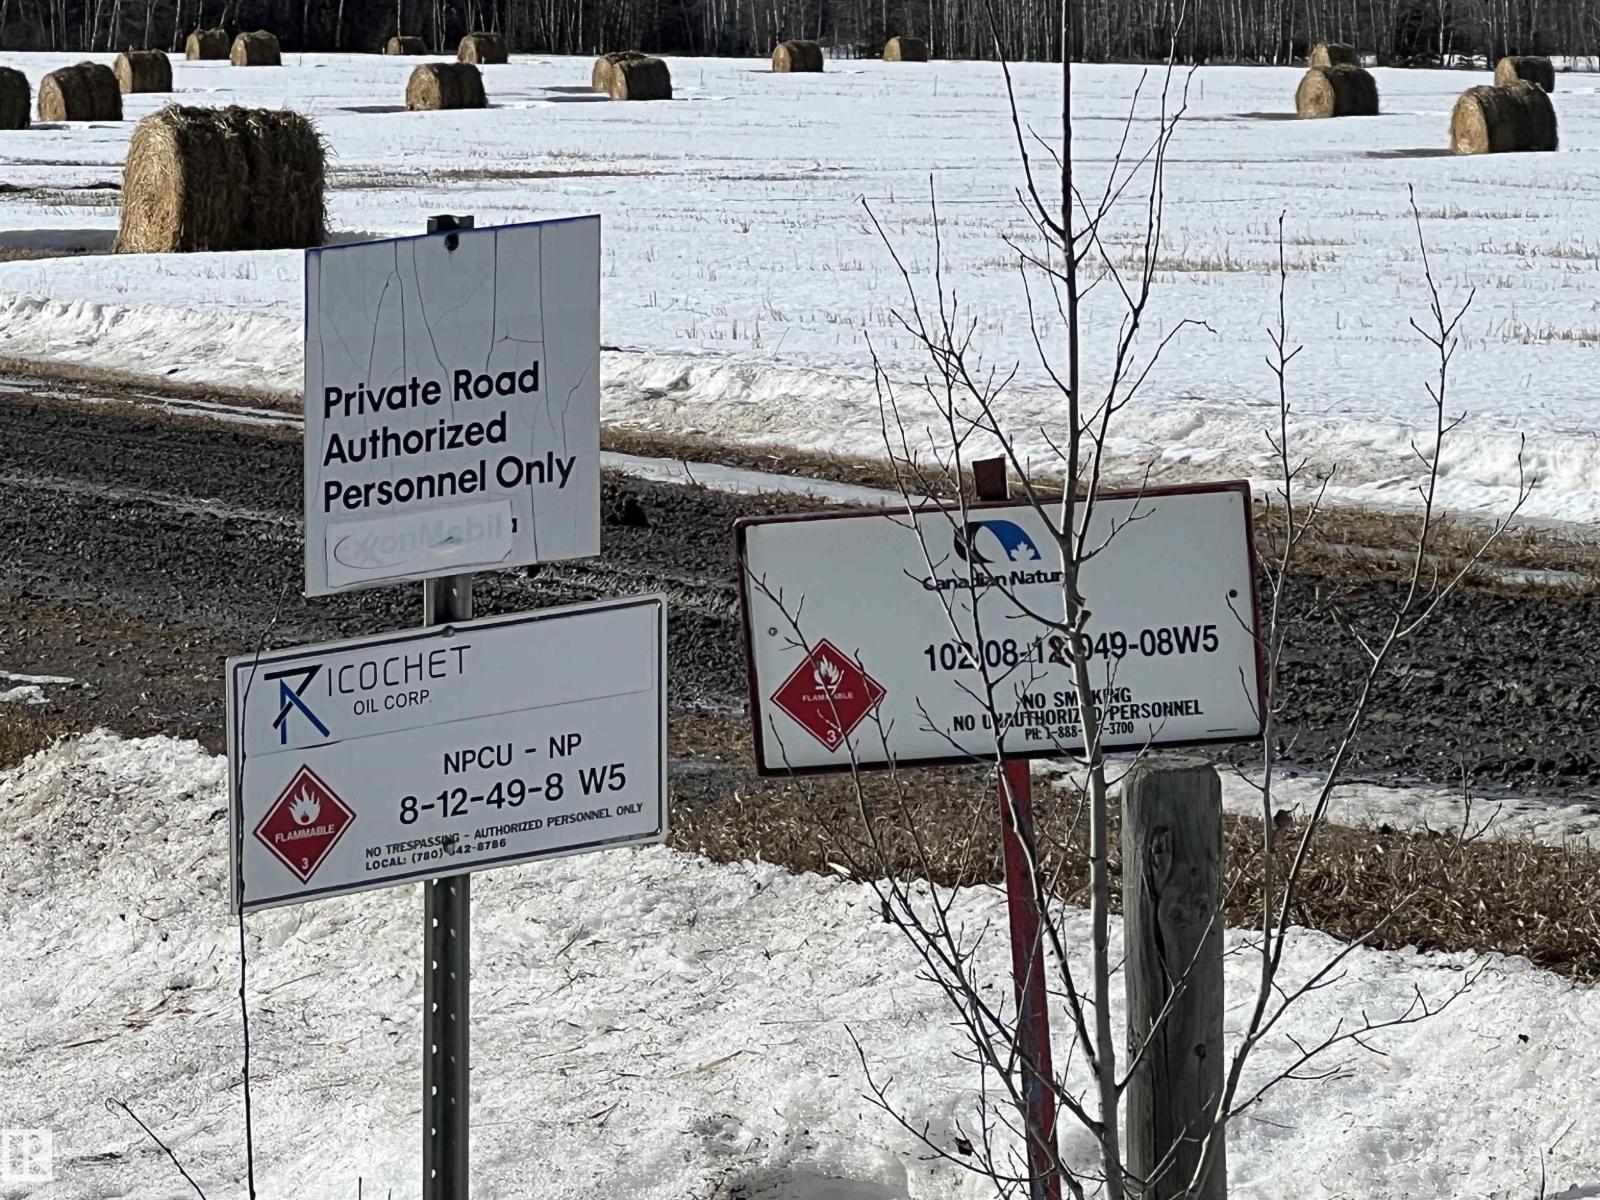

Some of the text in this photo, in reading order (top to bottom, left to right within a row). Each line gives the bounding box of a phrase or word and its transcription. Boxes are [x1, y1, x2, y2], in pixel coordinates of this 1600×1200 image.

[324, 361, 539, 419] Private Road
[323, 411, 507, 466] Authorized
[324, 451, 576, 512] Personnel Only
[1011, 570, 1064, 585] Natur
[353, 689, 432, 715] OIL CORP.
[802, 691, 854, 702] FLAMABLE
[1022, 687, 1132, 709] NO SMKING
[953, 699, 1204, 731] NO UNAUTHORIZD PERSONNEL
[827, 729, 837, 743] 3
[1046, 721, 1134, 740] 1-888--3700
[444, 743, 513, 775] NPCU
[550, 733, 582, 759] NP
[400, 763, 627, 825] 8-12-49-8 W5
[275, 824, 335, 843] FLAMMABLE
[365, 846, 382, 858] NO
[385, 833, 460, 855] TRESPASSING
[474, 819, 543, 840] AUTHORIZED
[547, 808, 612, 828] PERSONNEL
[616, 802, 644, 816] ONLY
[301, 857, 309, 870] 3
[365, 839, 507, 871] LOCAL: (780) 42-8786
